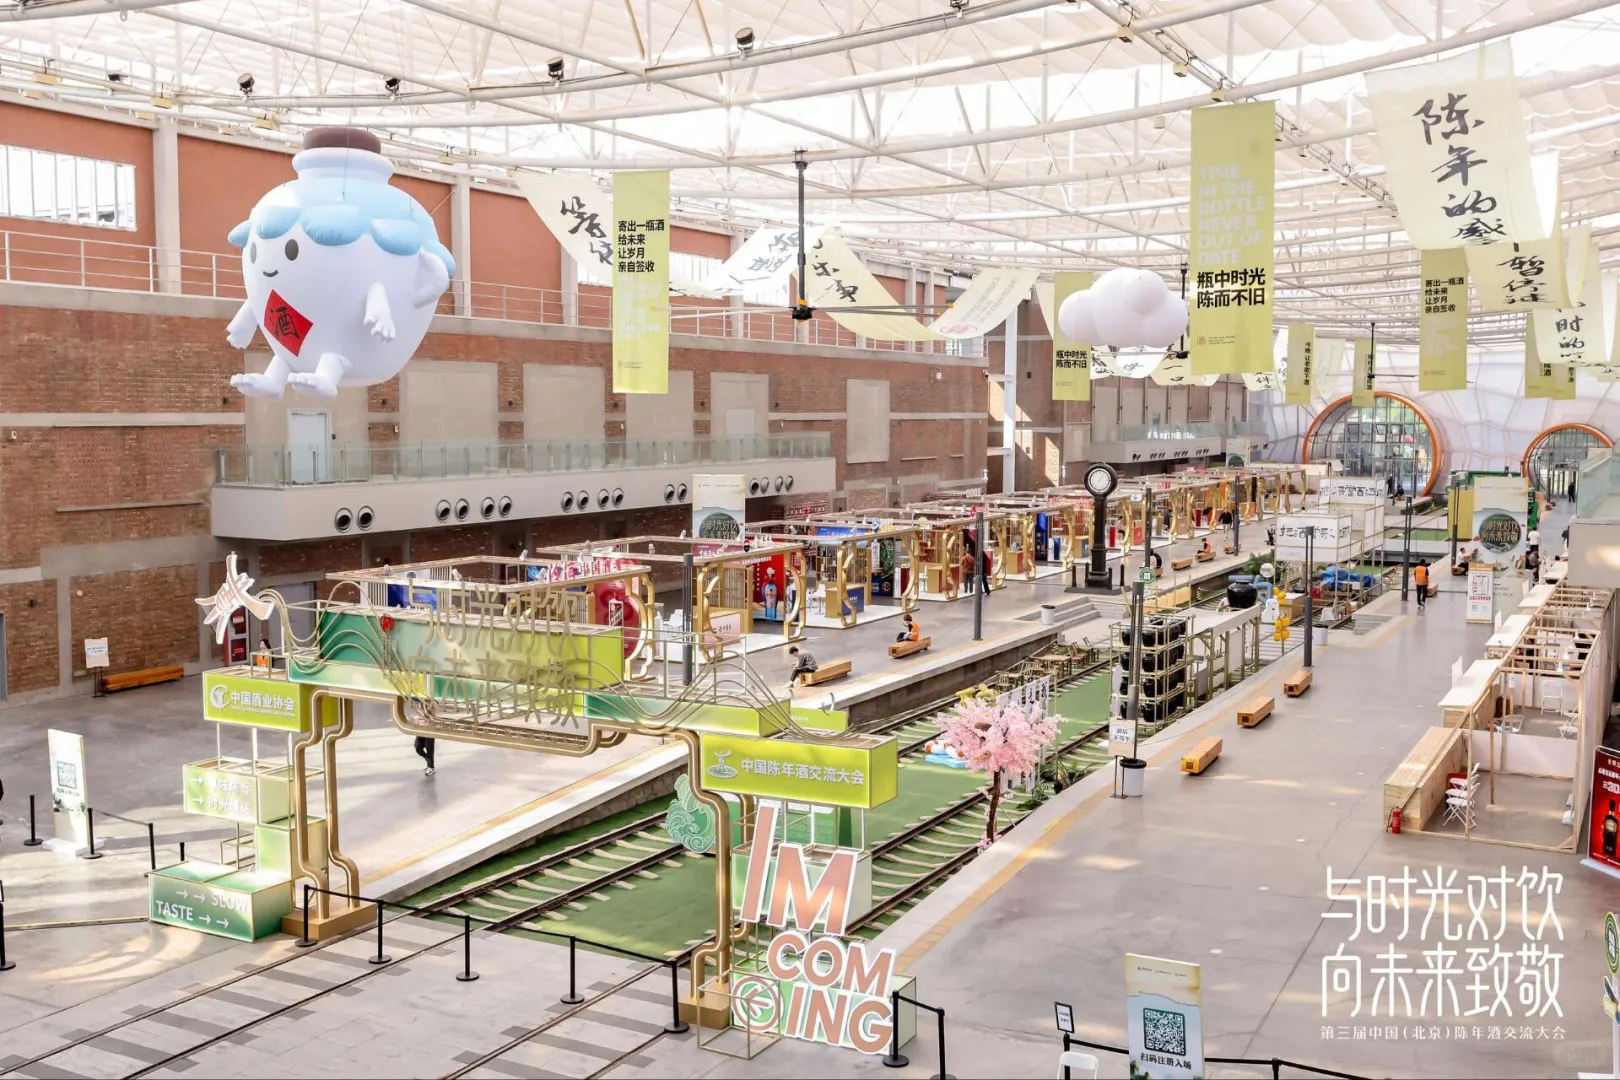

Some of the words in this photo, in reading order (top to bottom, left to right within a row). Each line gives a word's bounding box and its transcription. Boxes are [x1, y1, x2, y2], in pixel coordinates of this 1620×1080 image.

[1199, 163, 1241, 181] TIME
[1198, 184, 1217, 199] IN
[1221, 180, 1256, 196] THE
[1198, 196, 1267, 215] BOTTLE
[617, 219, 665, 232] 寄出一瓶酒
[1198, 213, 1257, 232] NEVER
[617, 233, 646, 246] 给未来
[1198, 232, 1235, 249] OUT
[1239, 230, 1264, 247] OF
[617, 247, 645, 260] 让岁月
[1198, 248, 1241, 267] DATE
[617, 261, 655, 273] 亲自签收
[1197, 267, 1266, 289] 瓶中时光
[1425, 277, 1465, 288] 寄出一瓶酒
[1197, 287, 1266, 309] 陈而不旧
[1425, 287, 1448, 296] 给未来
[1425, 296, 1448, 305] 让岁月
[1425, 304, 1456, 314] 亲自签收
[269, 306, 300, 340] 酒
[1055, 349, 1088, 359] 瓶中时光
[1055, 358, 1088, 369] 陈而不旧
[231, 689, 296, 711] 中国酒业协会
[741, 757, 865, 785] 中国陈年酒交流大会
[155, 900, 194, 922] TASTE
[211, 890, 249, 914] SLOW
[766, 930, 896, 1000] COM
[785, 981, 894, 1055] ING
[1140, 1051, 1192, 1071] 扫码注册入场
